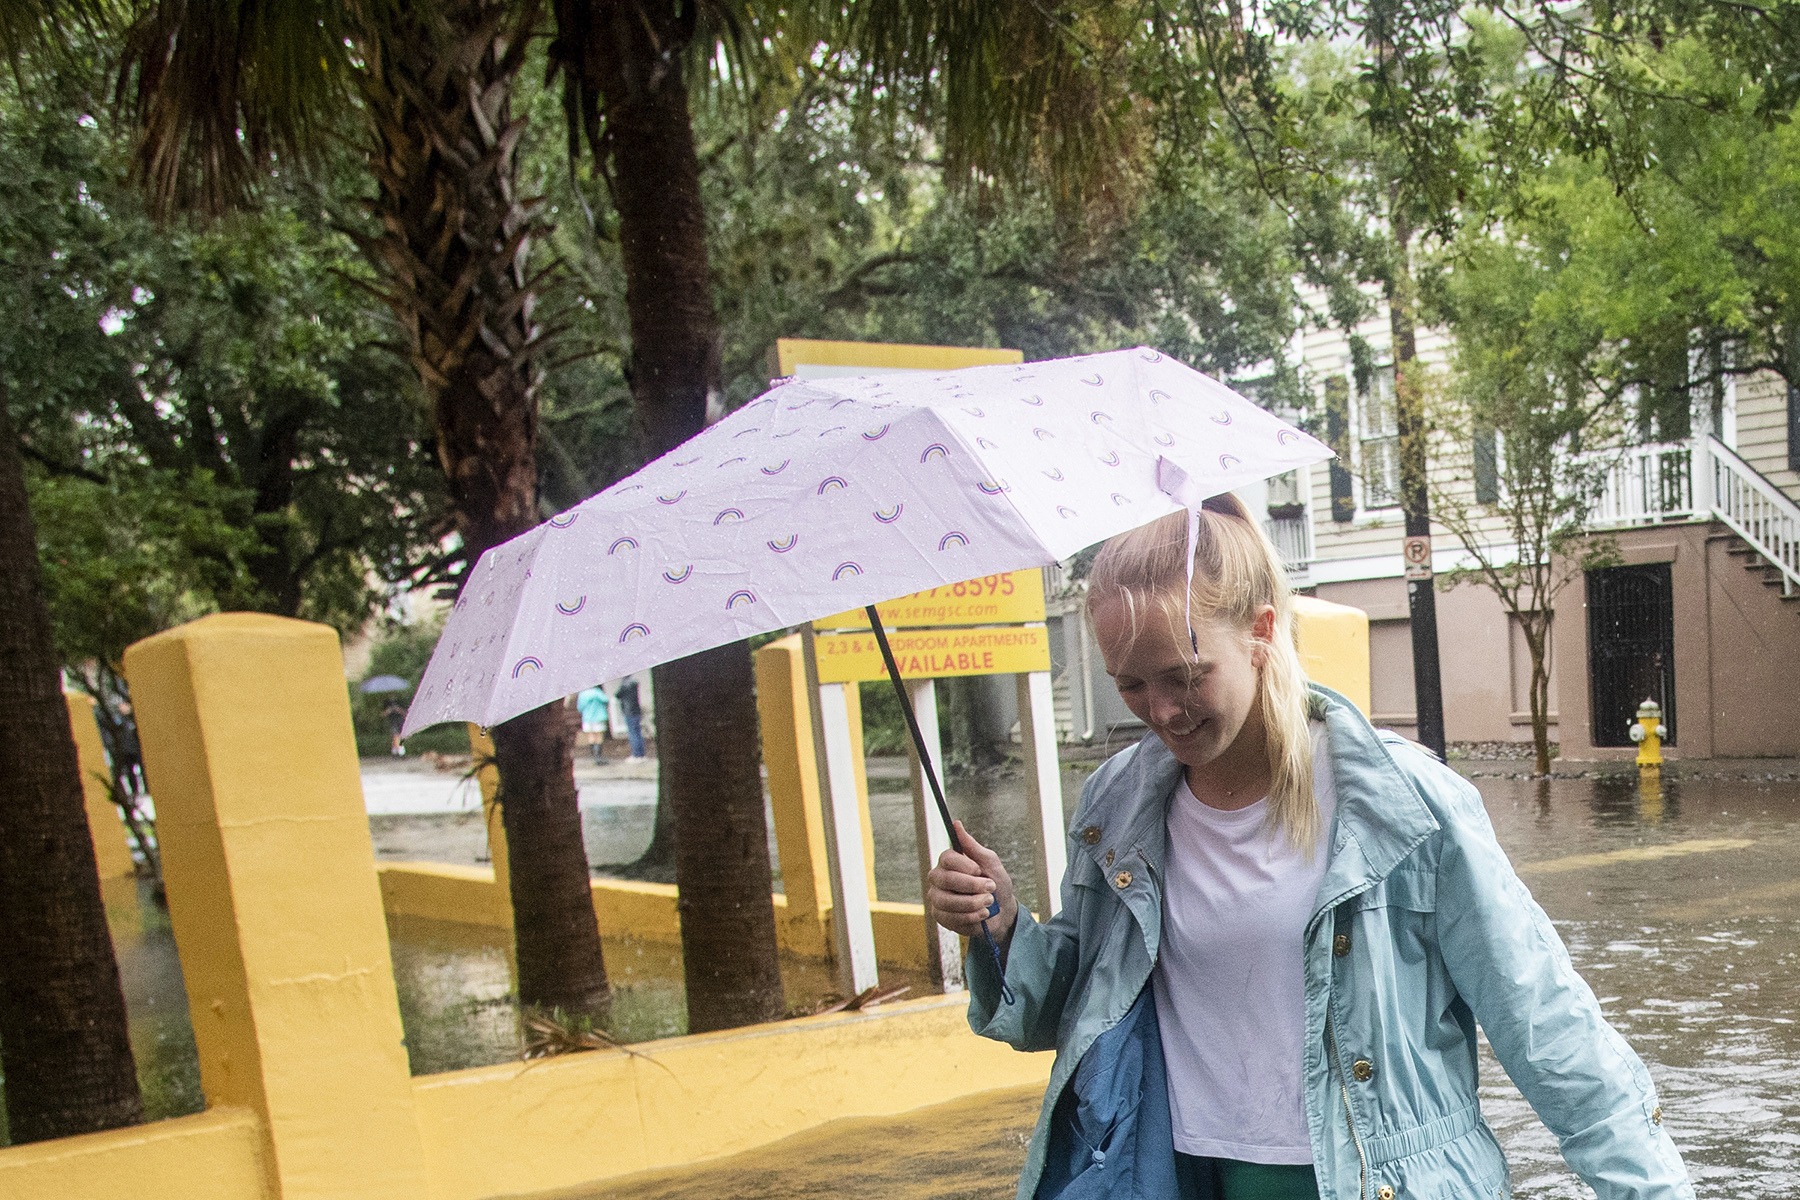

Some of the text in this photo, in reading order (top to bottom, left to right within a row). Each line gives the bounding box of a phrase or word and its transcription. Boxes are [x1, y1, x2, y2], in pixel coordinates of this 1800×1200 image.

[857, 604, 998, 622] ww.semgsc.com
[853, 640, 862, 653] &
[867, 640, 875, 651] 4
[888, 636, 949, 651] EDROOM
[953, 633, 1038, 648] APARTMENTS
